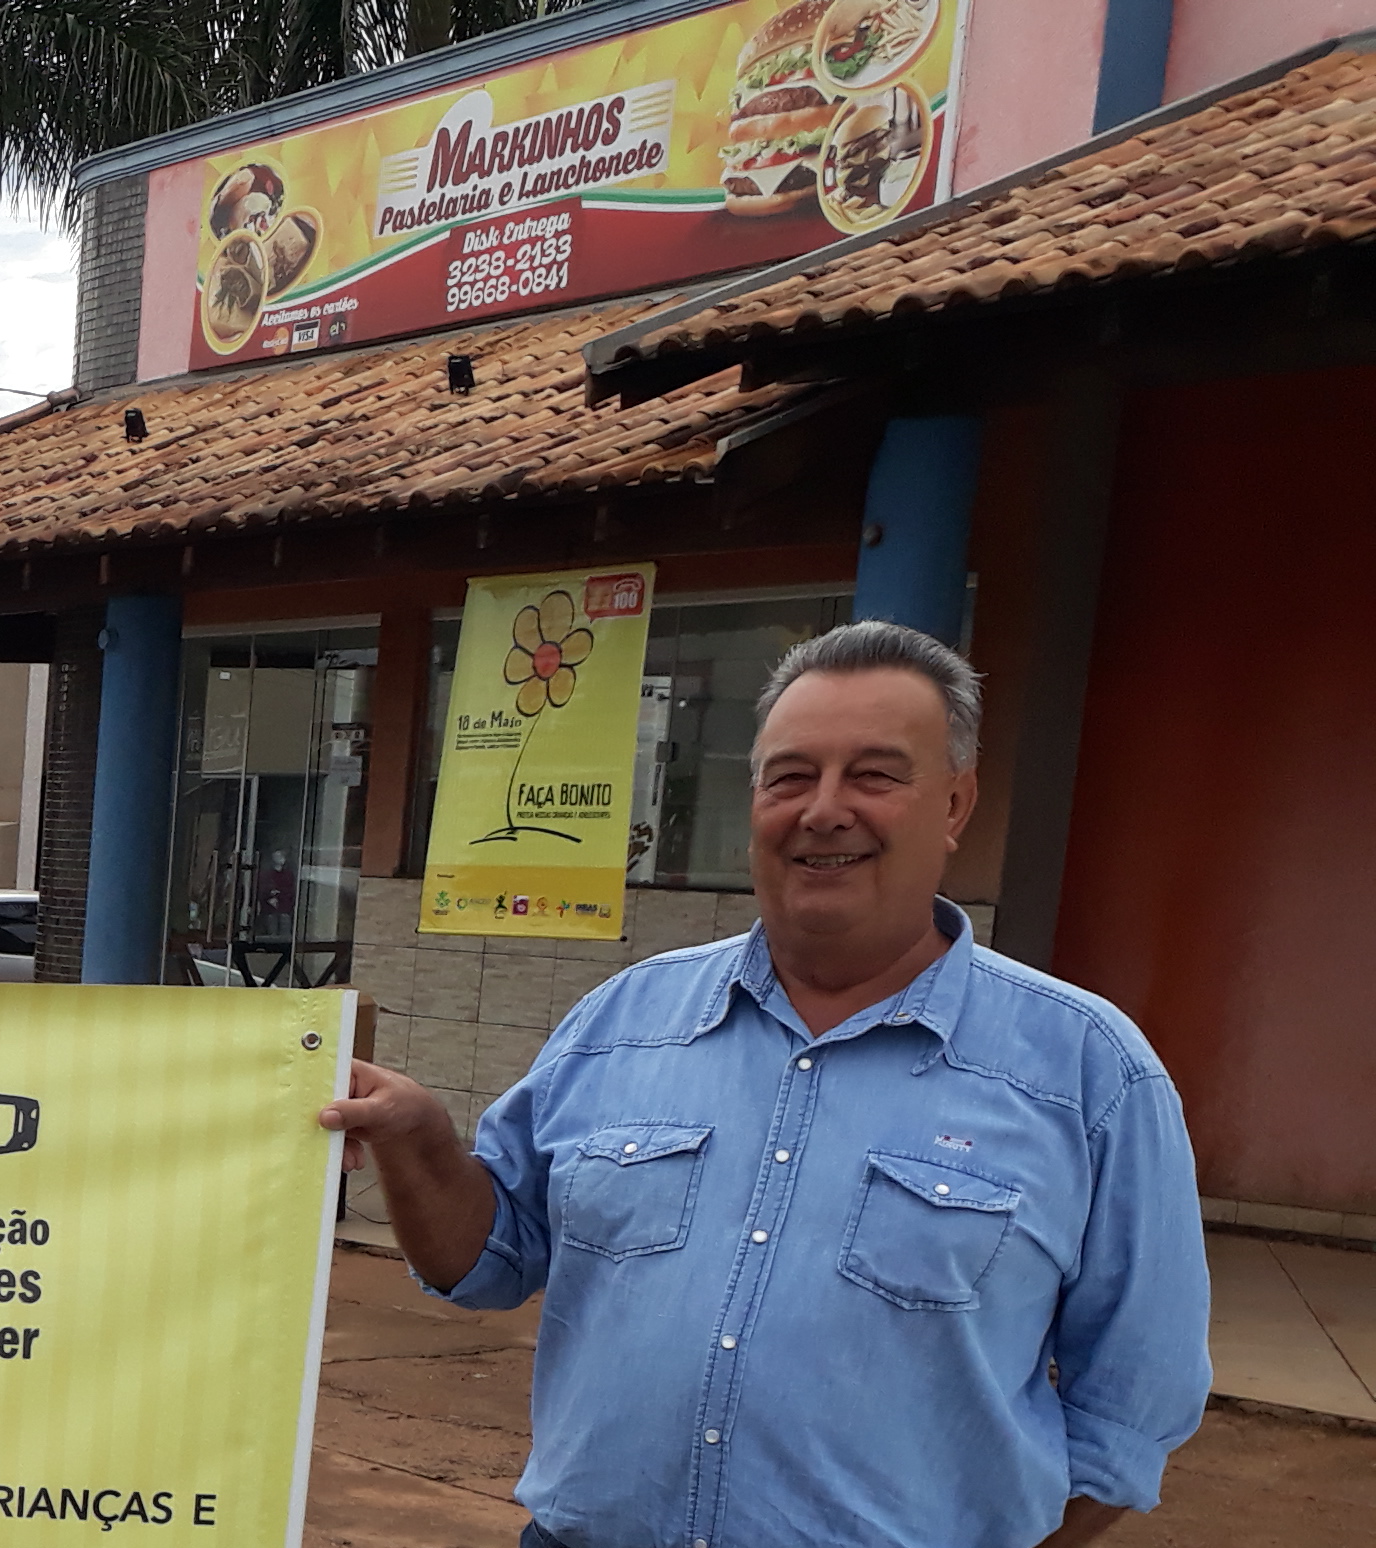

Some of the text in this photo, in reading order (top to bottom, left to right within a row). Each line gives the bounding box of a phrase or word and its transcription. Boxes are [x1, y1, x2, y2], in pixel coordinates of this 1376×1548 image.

[379, 138, 664, 235] Pastelaria e Lanchonete
[462, 212, 571, 254] Disk Entrega
[448, 234, 572, 286] 3238-2133
[447, 262, 568, 312] 99668-0841
[615, 592, 637, 609] 100
[518, 784, 612, 808] FAÇA BONITO
[194, 1494, 216, 1525] E
